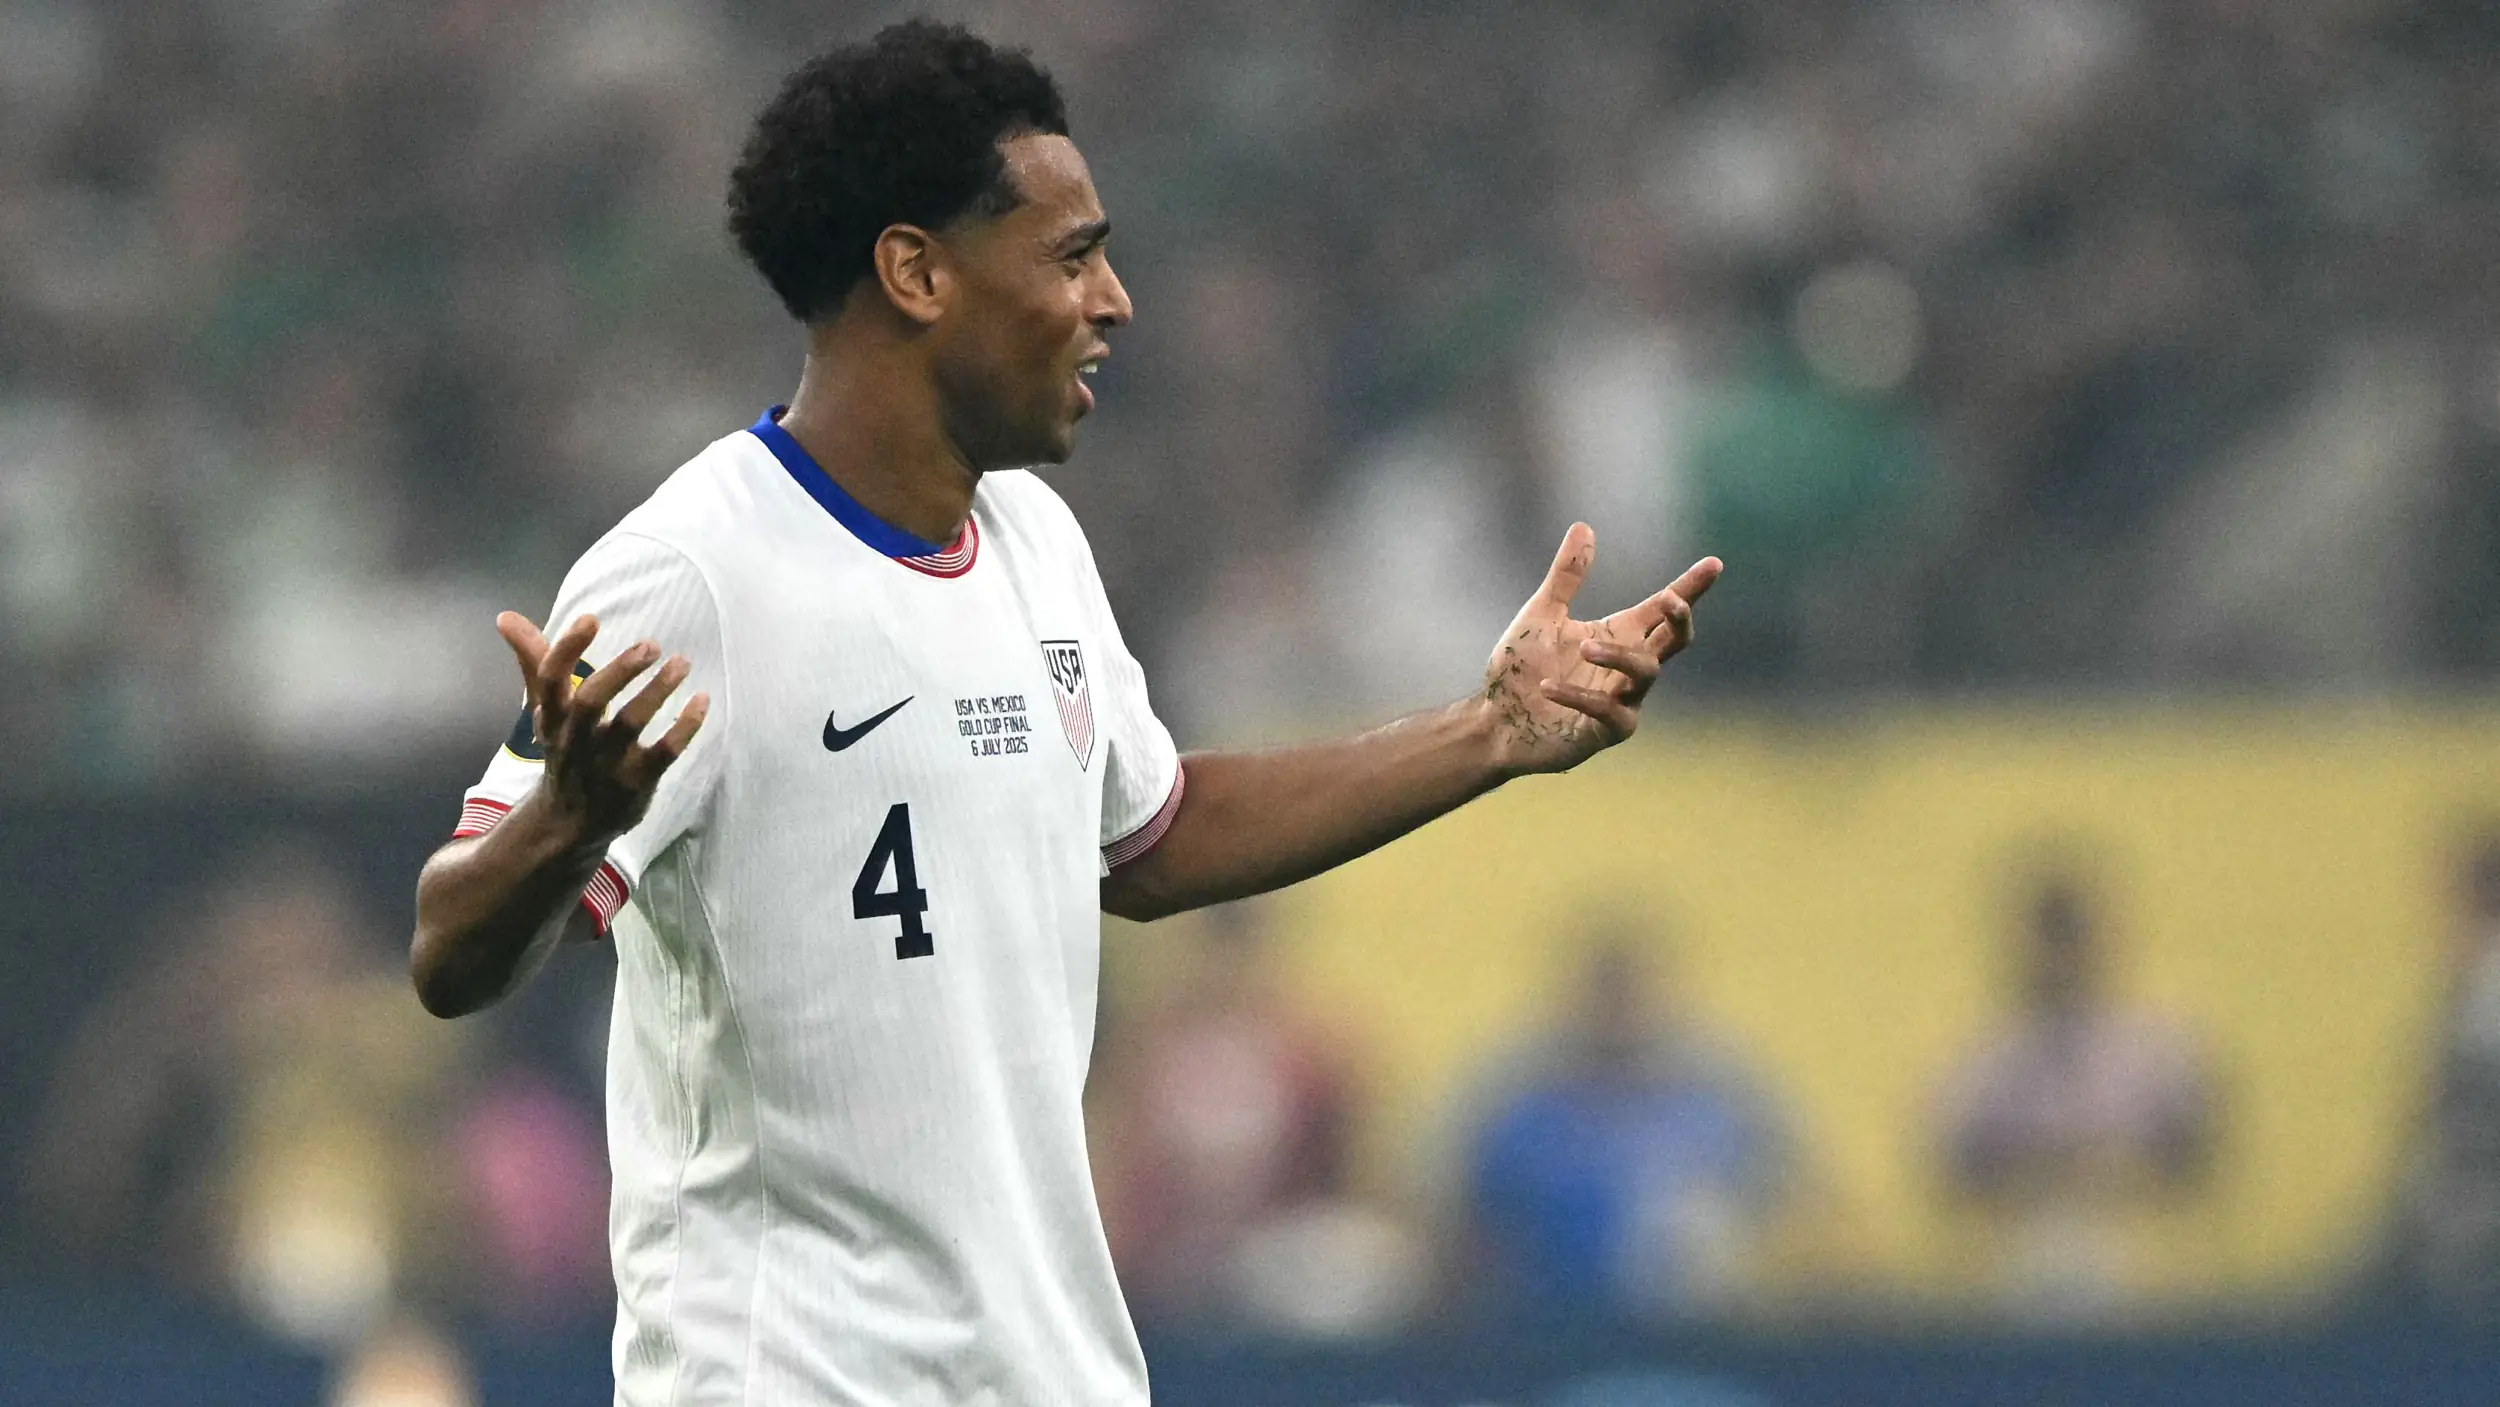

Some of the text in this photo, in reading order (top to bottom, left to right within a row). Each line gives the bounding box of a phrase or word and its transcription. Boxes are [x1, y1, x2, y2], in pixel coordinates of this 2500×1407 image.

[1046, 649, 1082, 695] USA
[954, 695, 1027, 716] USA VS. MEXICO
[958, 715, 1032, 736] GOLD CUP FINAL
[971, 736, 1029, 757] 6 JULY 2025
[852, 802, 935, 960] 4
